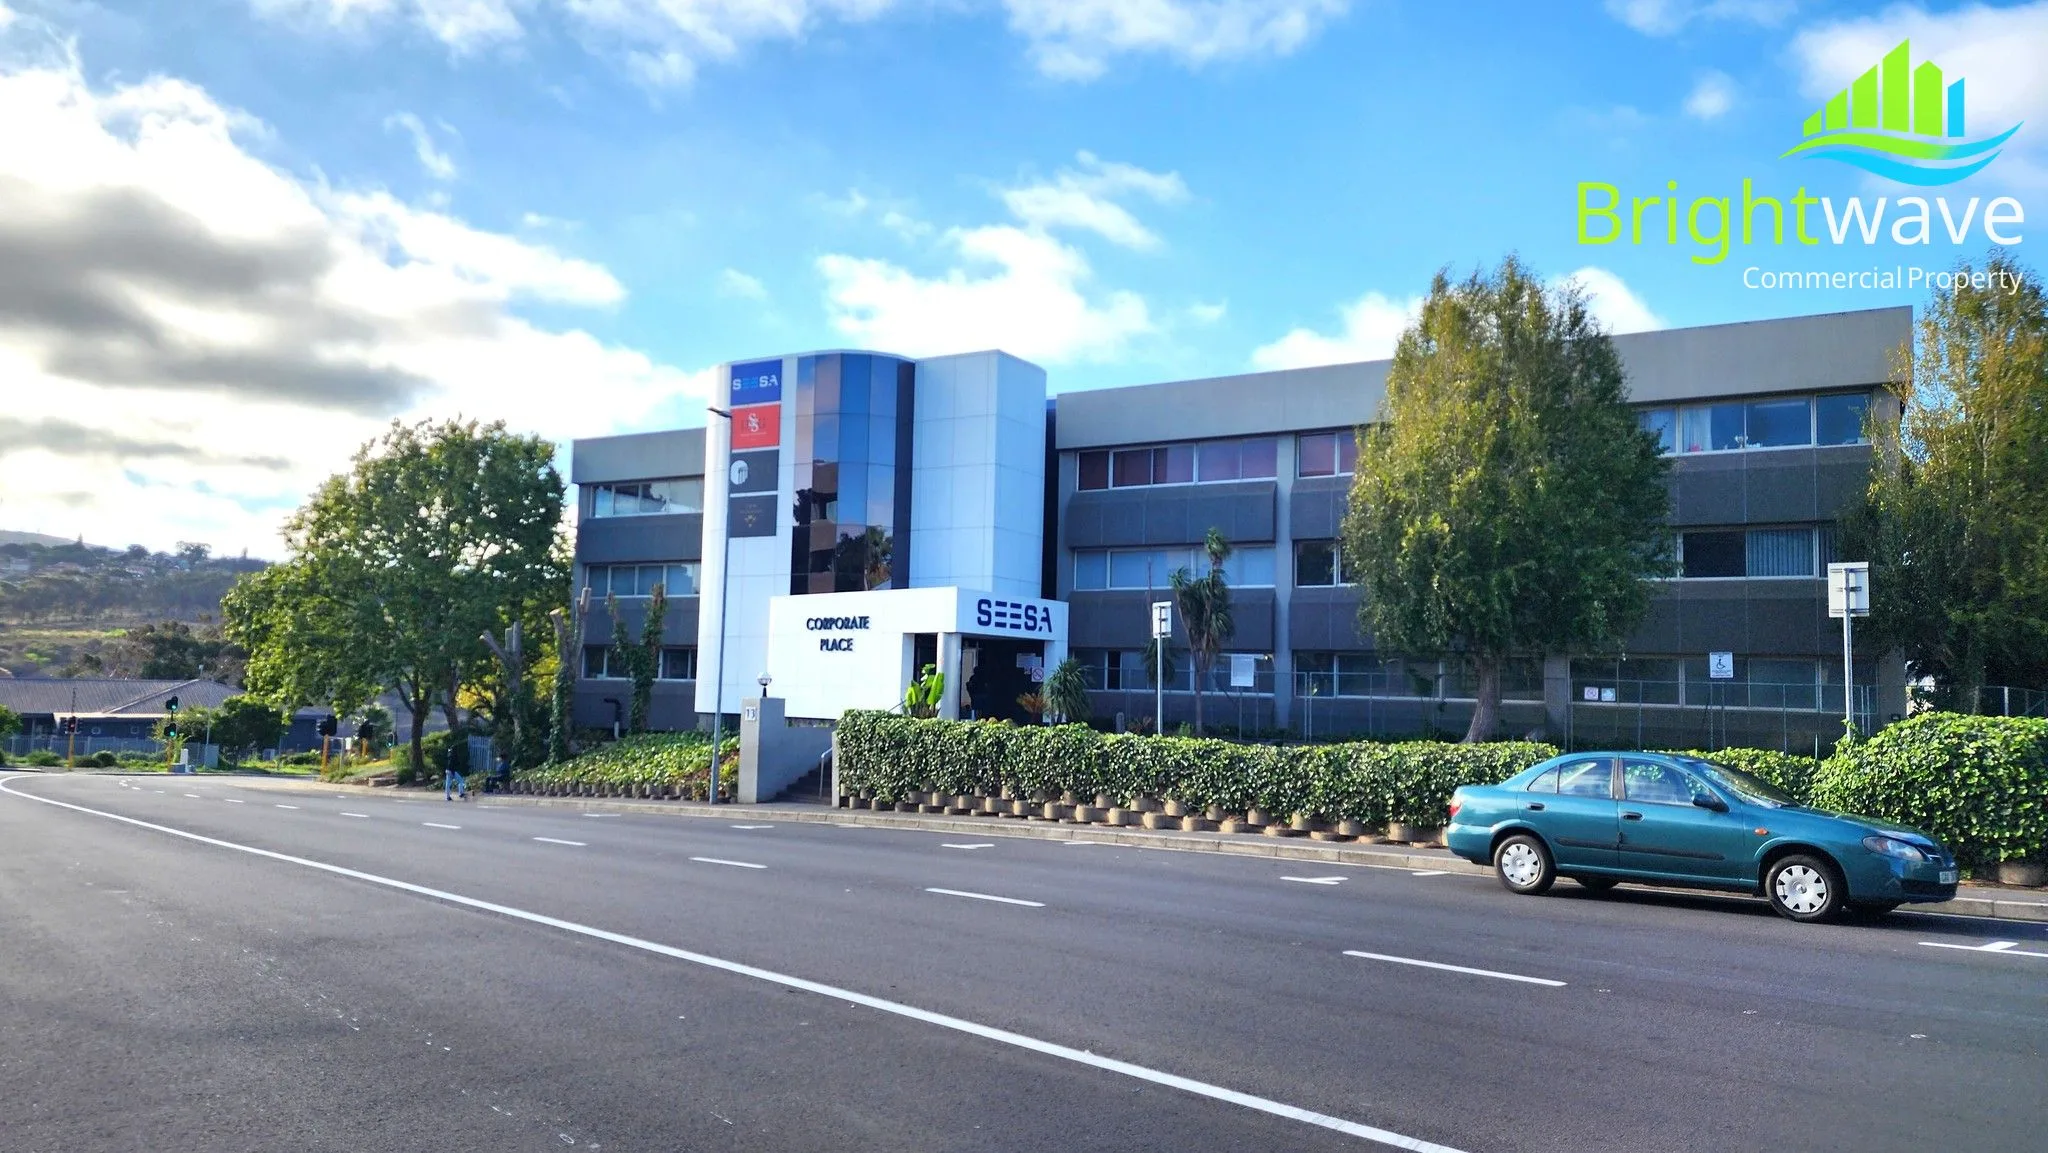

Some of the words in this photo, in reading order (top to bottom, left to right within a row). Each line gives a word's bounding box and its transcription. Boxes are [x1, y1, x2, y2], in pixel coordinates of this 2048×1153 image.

[733, 375, 778, 390] SEESA
[806, 616, 870, 630] CORPORATE
[977, 599, 1052, 632] SEESA
[820, 637, 854, 652] PLACE
